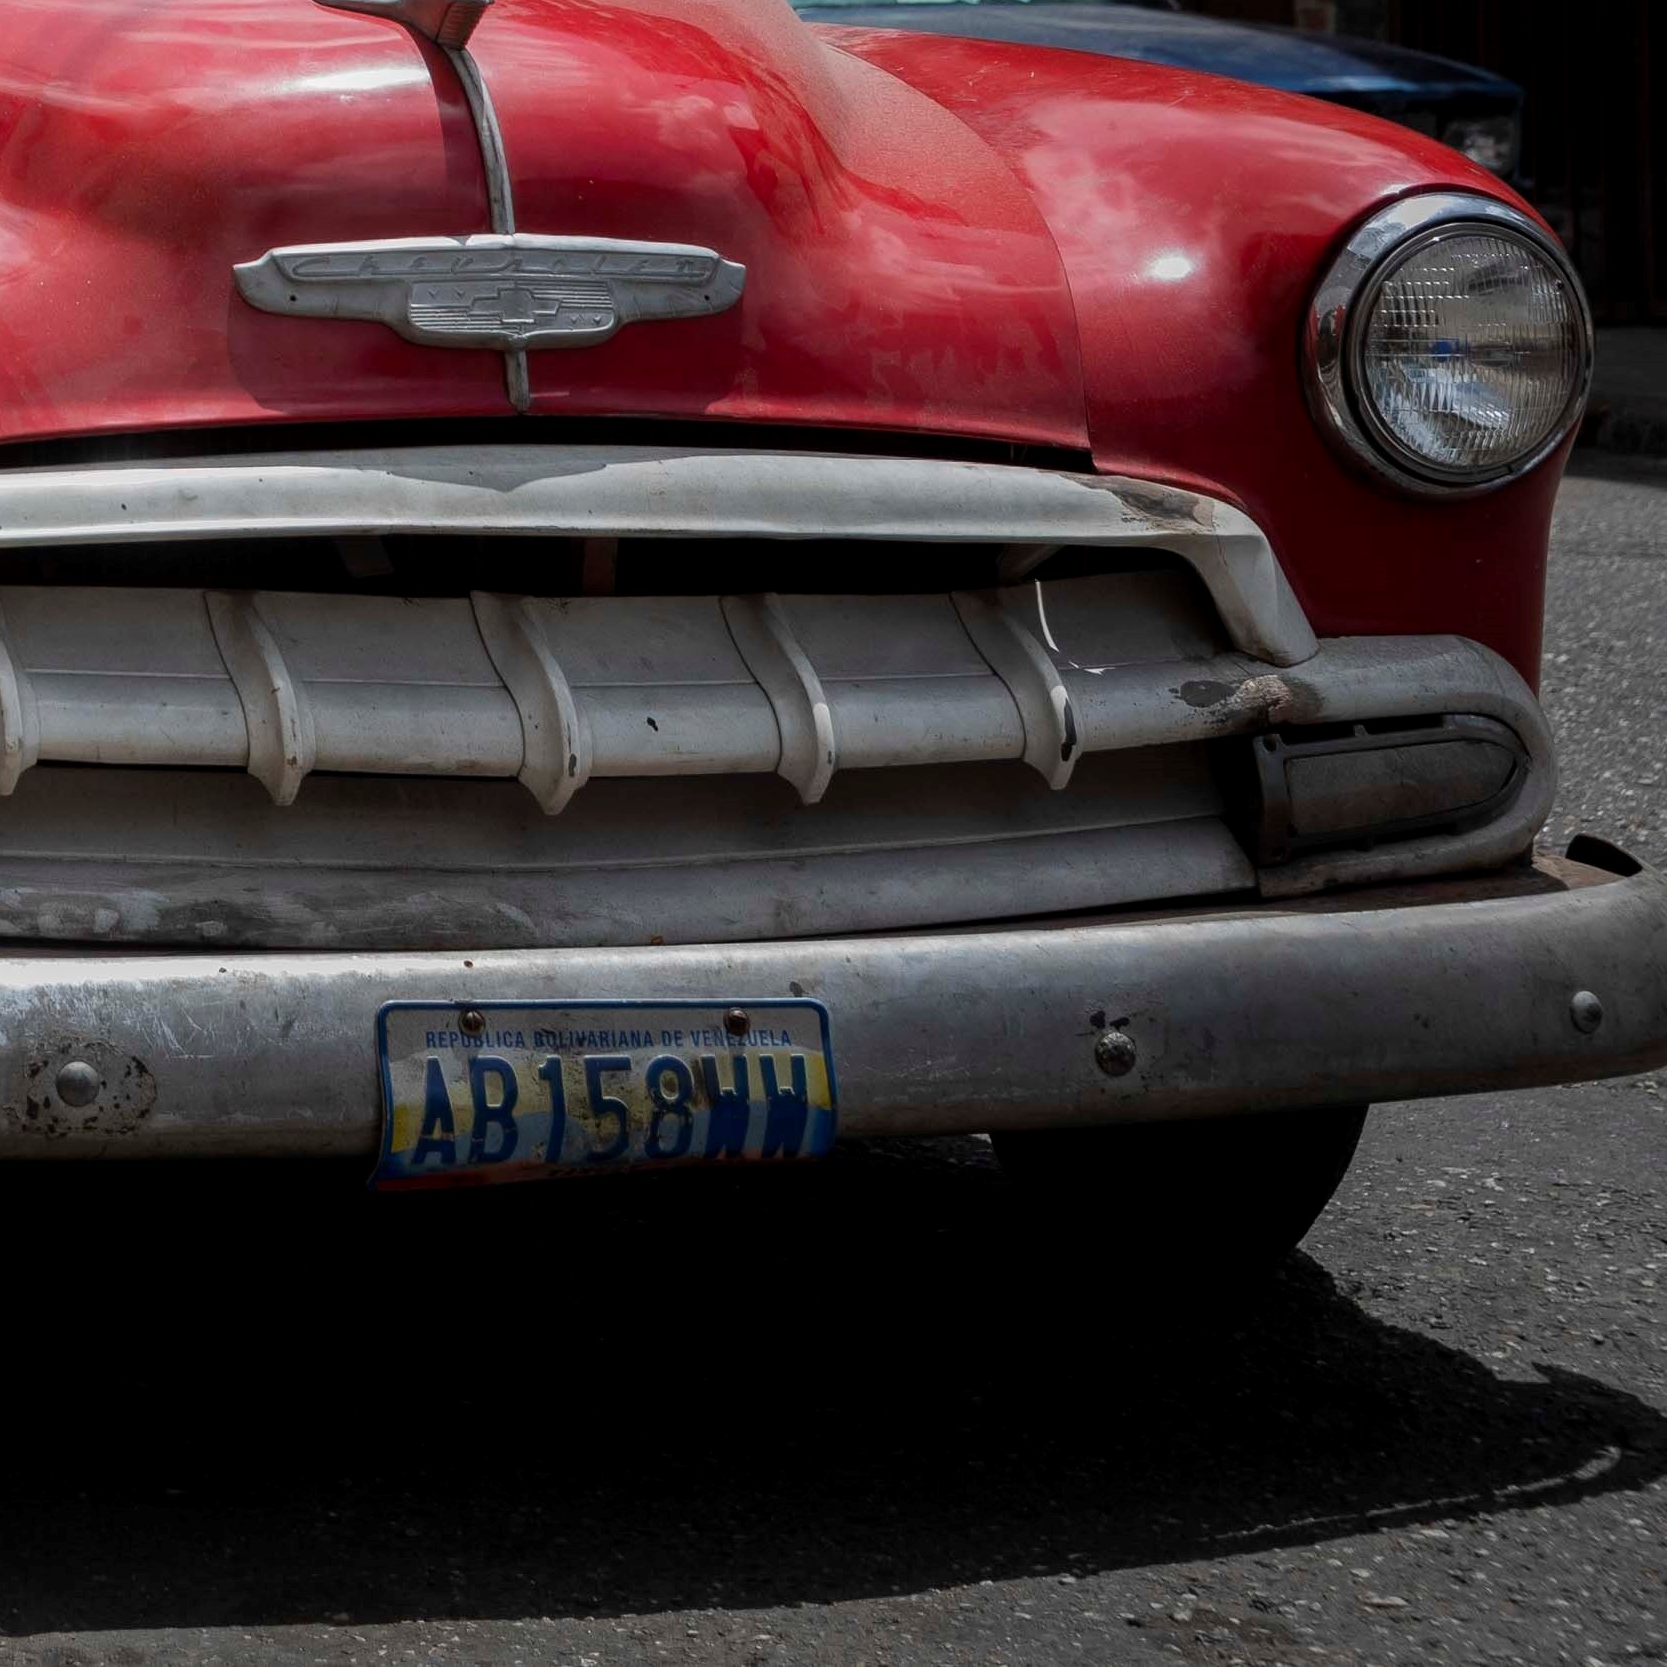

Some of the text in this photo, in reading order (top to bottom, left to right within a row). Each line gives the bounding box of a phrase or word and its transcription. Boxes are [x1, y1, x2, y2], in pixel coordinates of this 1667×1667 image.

[533, 1029, 654, 1048] BOLIVARIANA
[661, 1029, 685, 1048] DE
[688, 1029, 793, 1048] VENEZUELA
